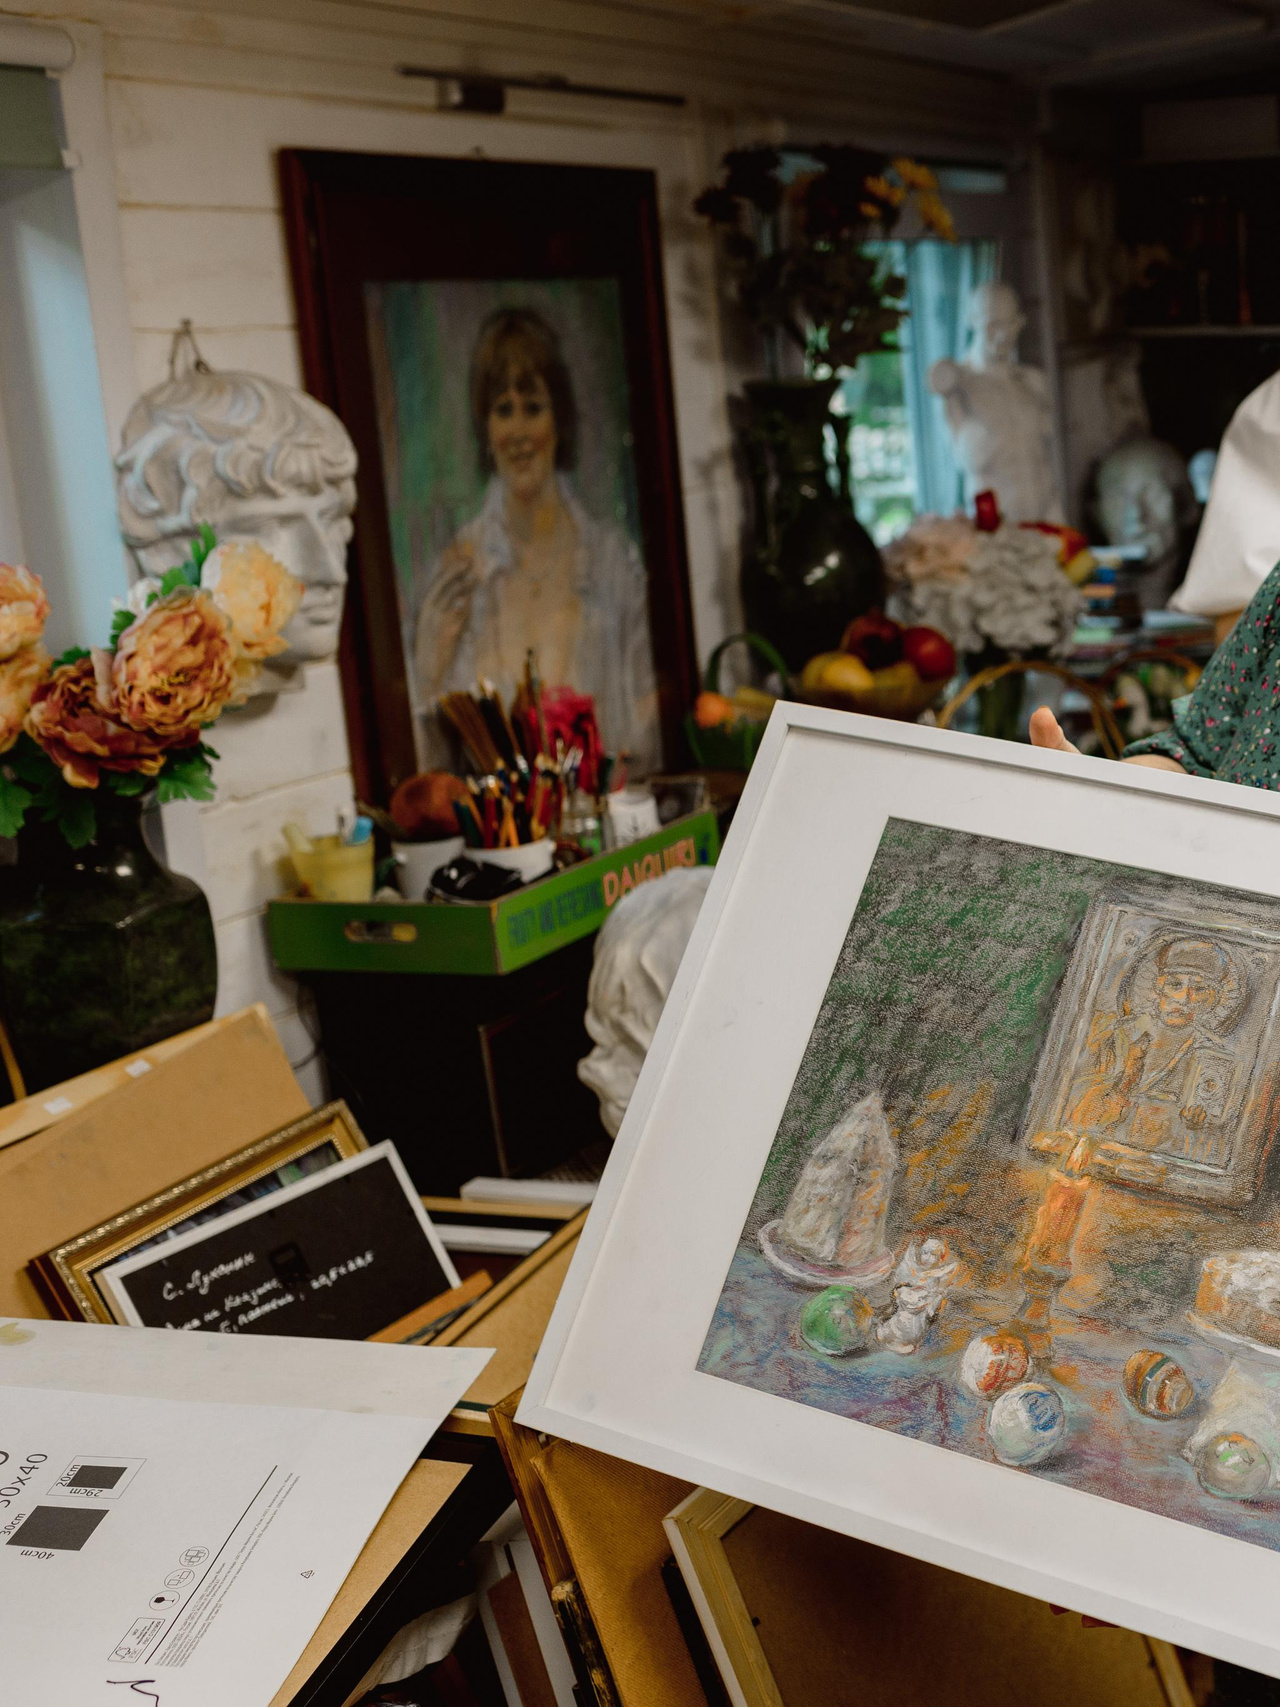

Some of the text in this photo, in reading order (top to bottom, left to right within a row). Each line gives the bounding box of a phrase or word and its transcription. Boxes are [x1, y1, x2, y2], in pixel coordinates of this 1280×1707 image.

[56, 1464, 81, 1488] 20cm
[69, 1487, 104, 1497] 29cm
[0, 1513, 26, 1536] 30cm
[20, 1549, 55, 1560] 40cm
